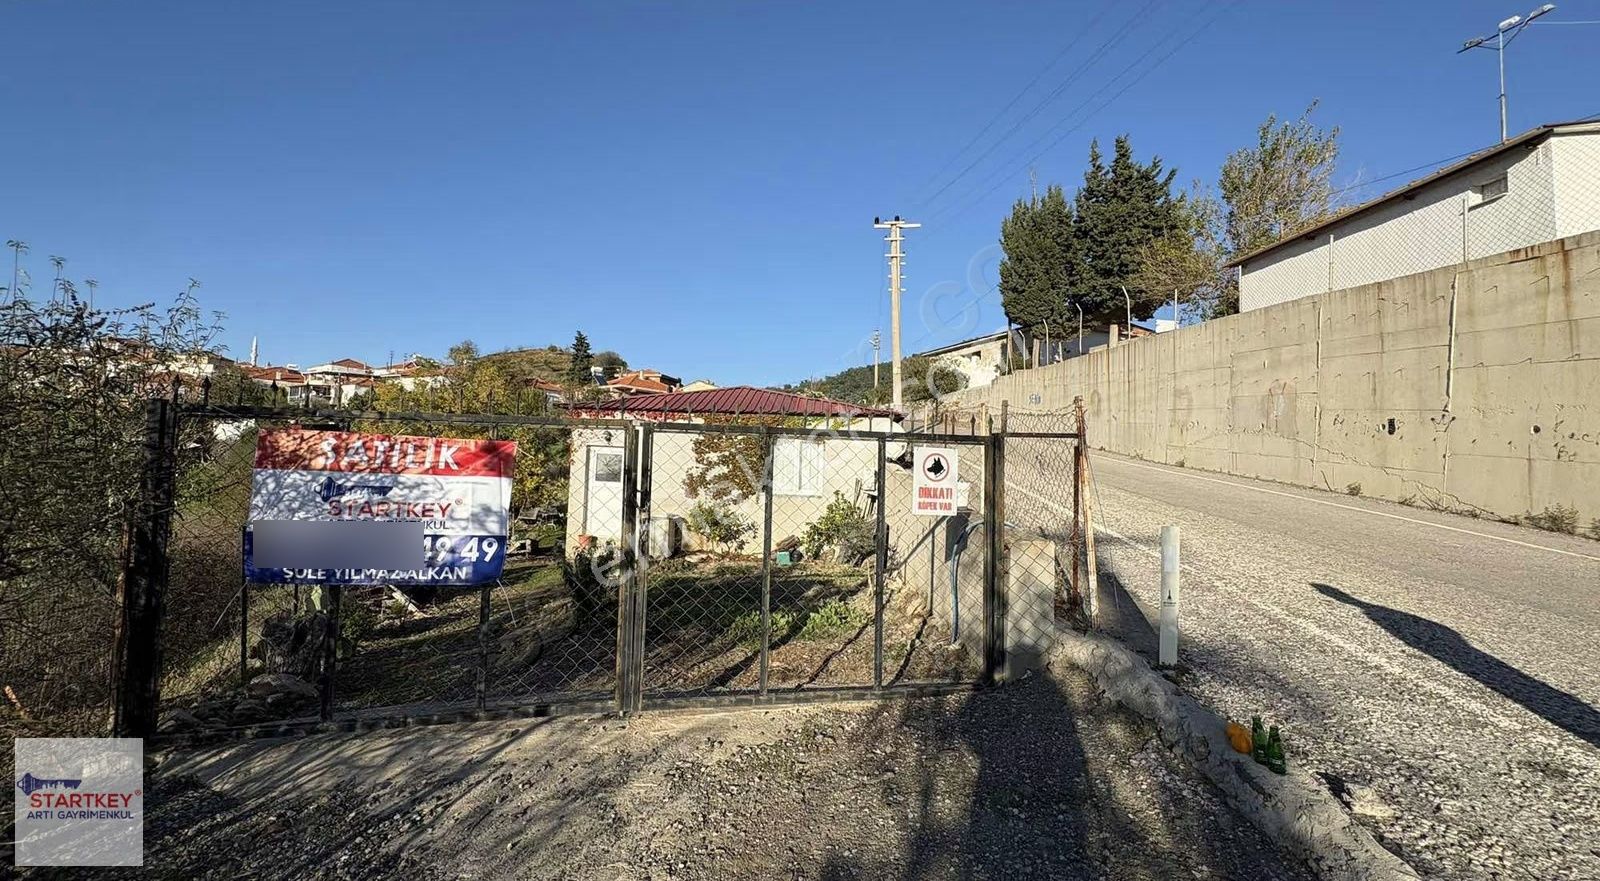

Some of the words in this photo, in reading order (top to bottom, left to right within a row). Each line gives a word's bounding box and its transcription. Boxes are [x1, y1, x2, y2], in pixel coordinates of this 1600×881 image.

[321, 437, 459, 470] SATILIK
[327, 500, 451, 518] STARTKEY
[939, 502, 952, 511] VAR
[460, 537, 499, 563] 49
